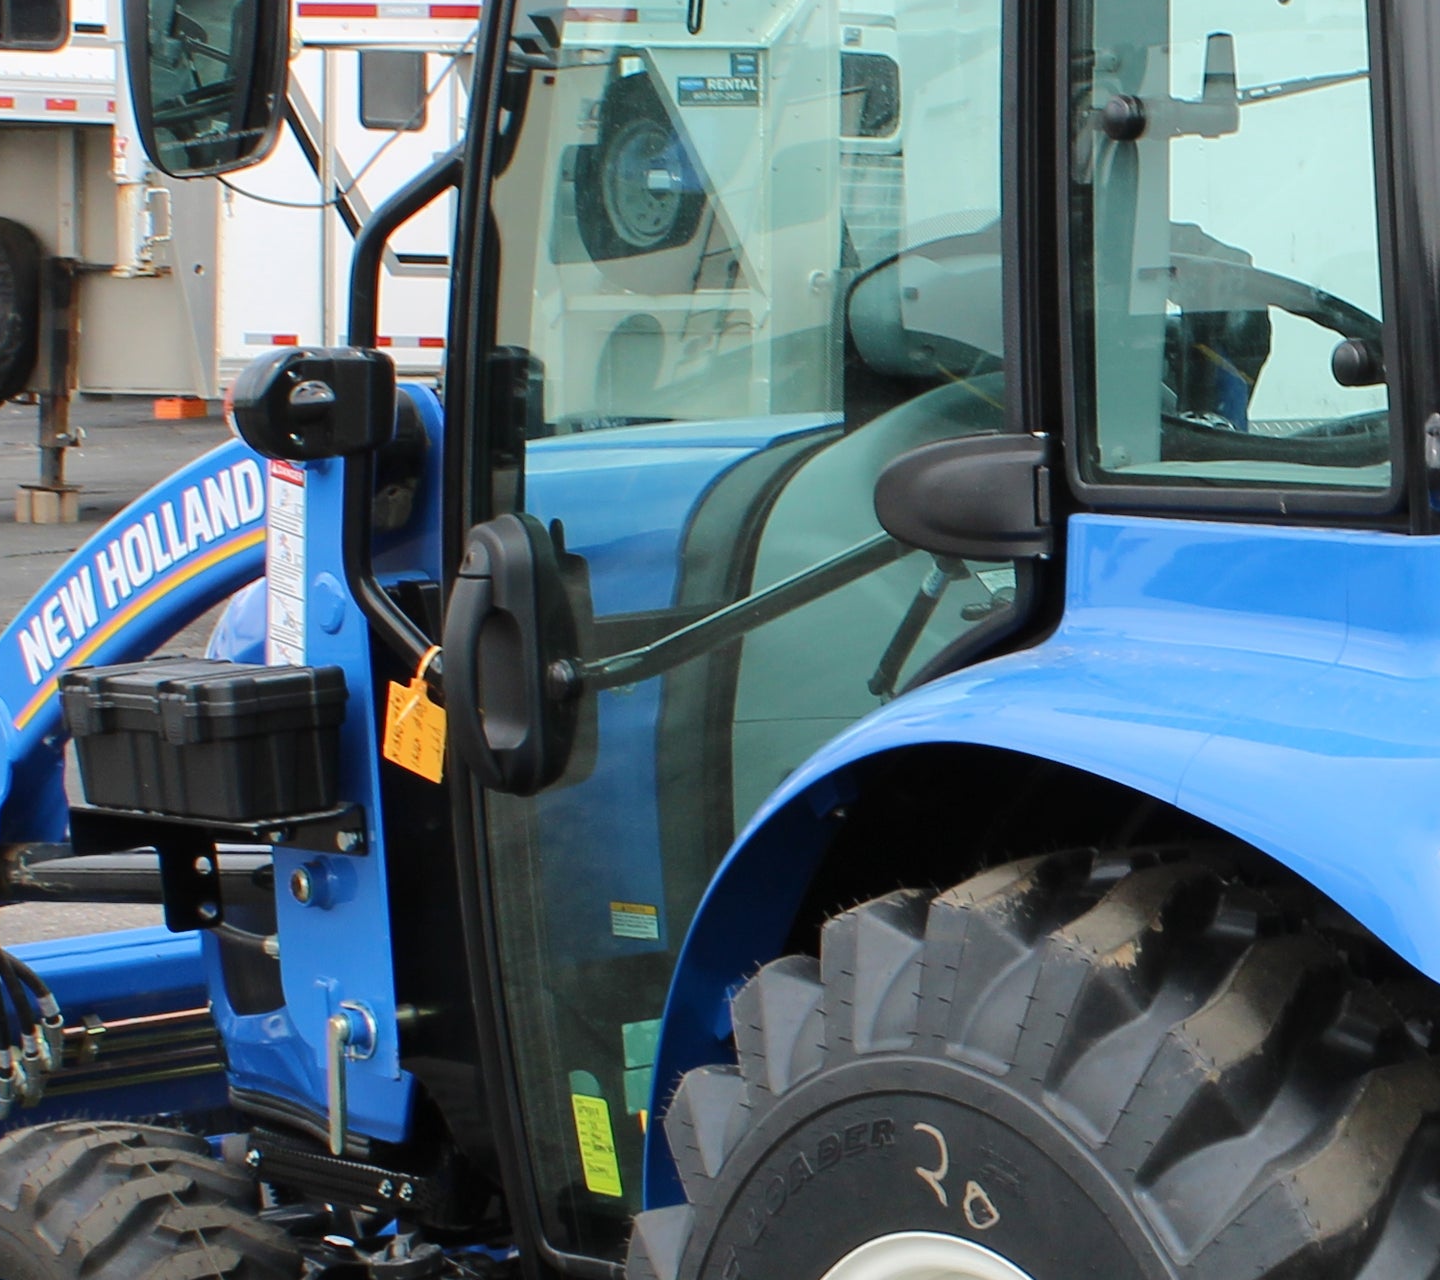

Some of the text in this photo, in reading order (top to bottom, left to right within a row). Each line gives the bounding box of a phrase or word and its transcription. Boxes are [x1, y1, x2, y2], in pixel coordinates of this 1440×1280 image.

[706, 78, 758, 91] RENTAL
[18, 565, 99, 685] NEW
[94, 458, 266, 610] HOLLAND
[744, 1117, 897, 1248] LOADER
